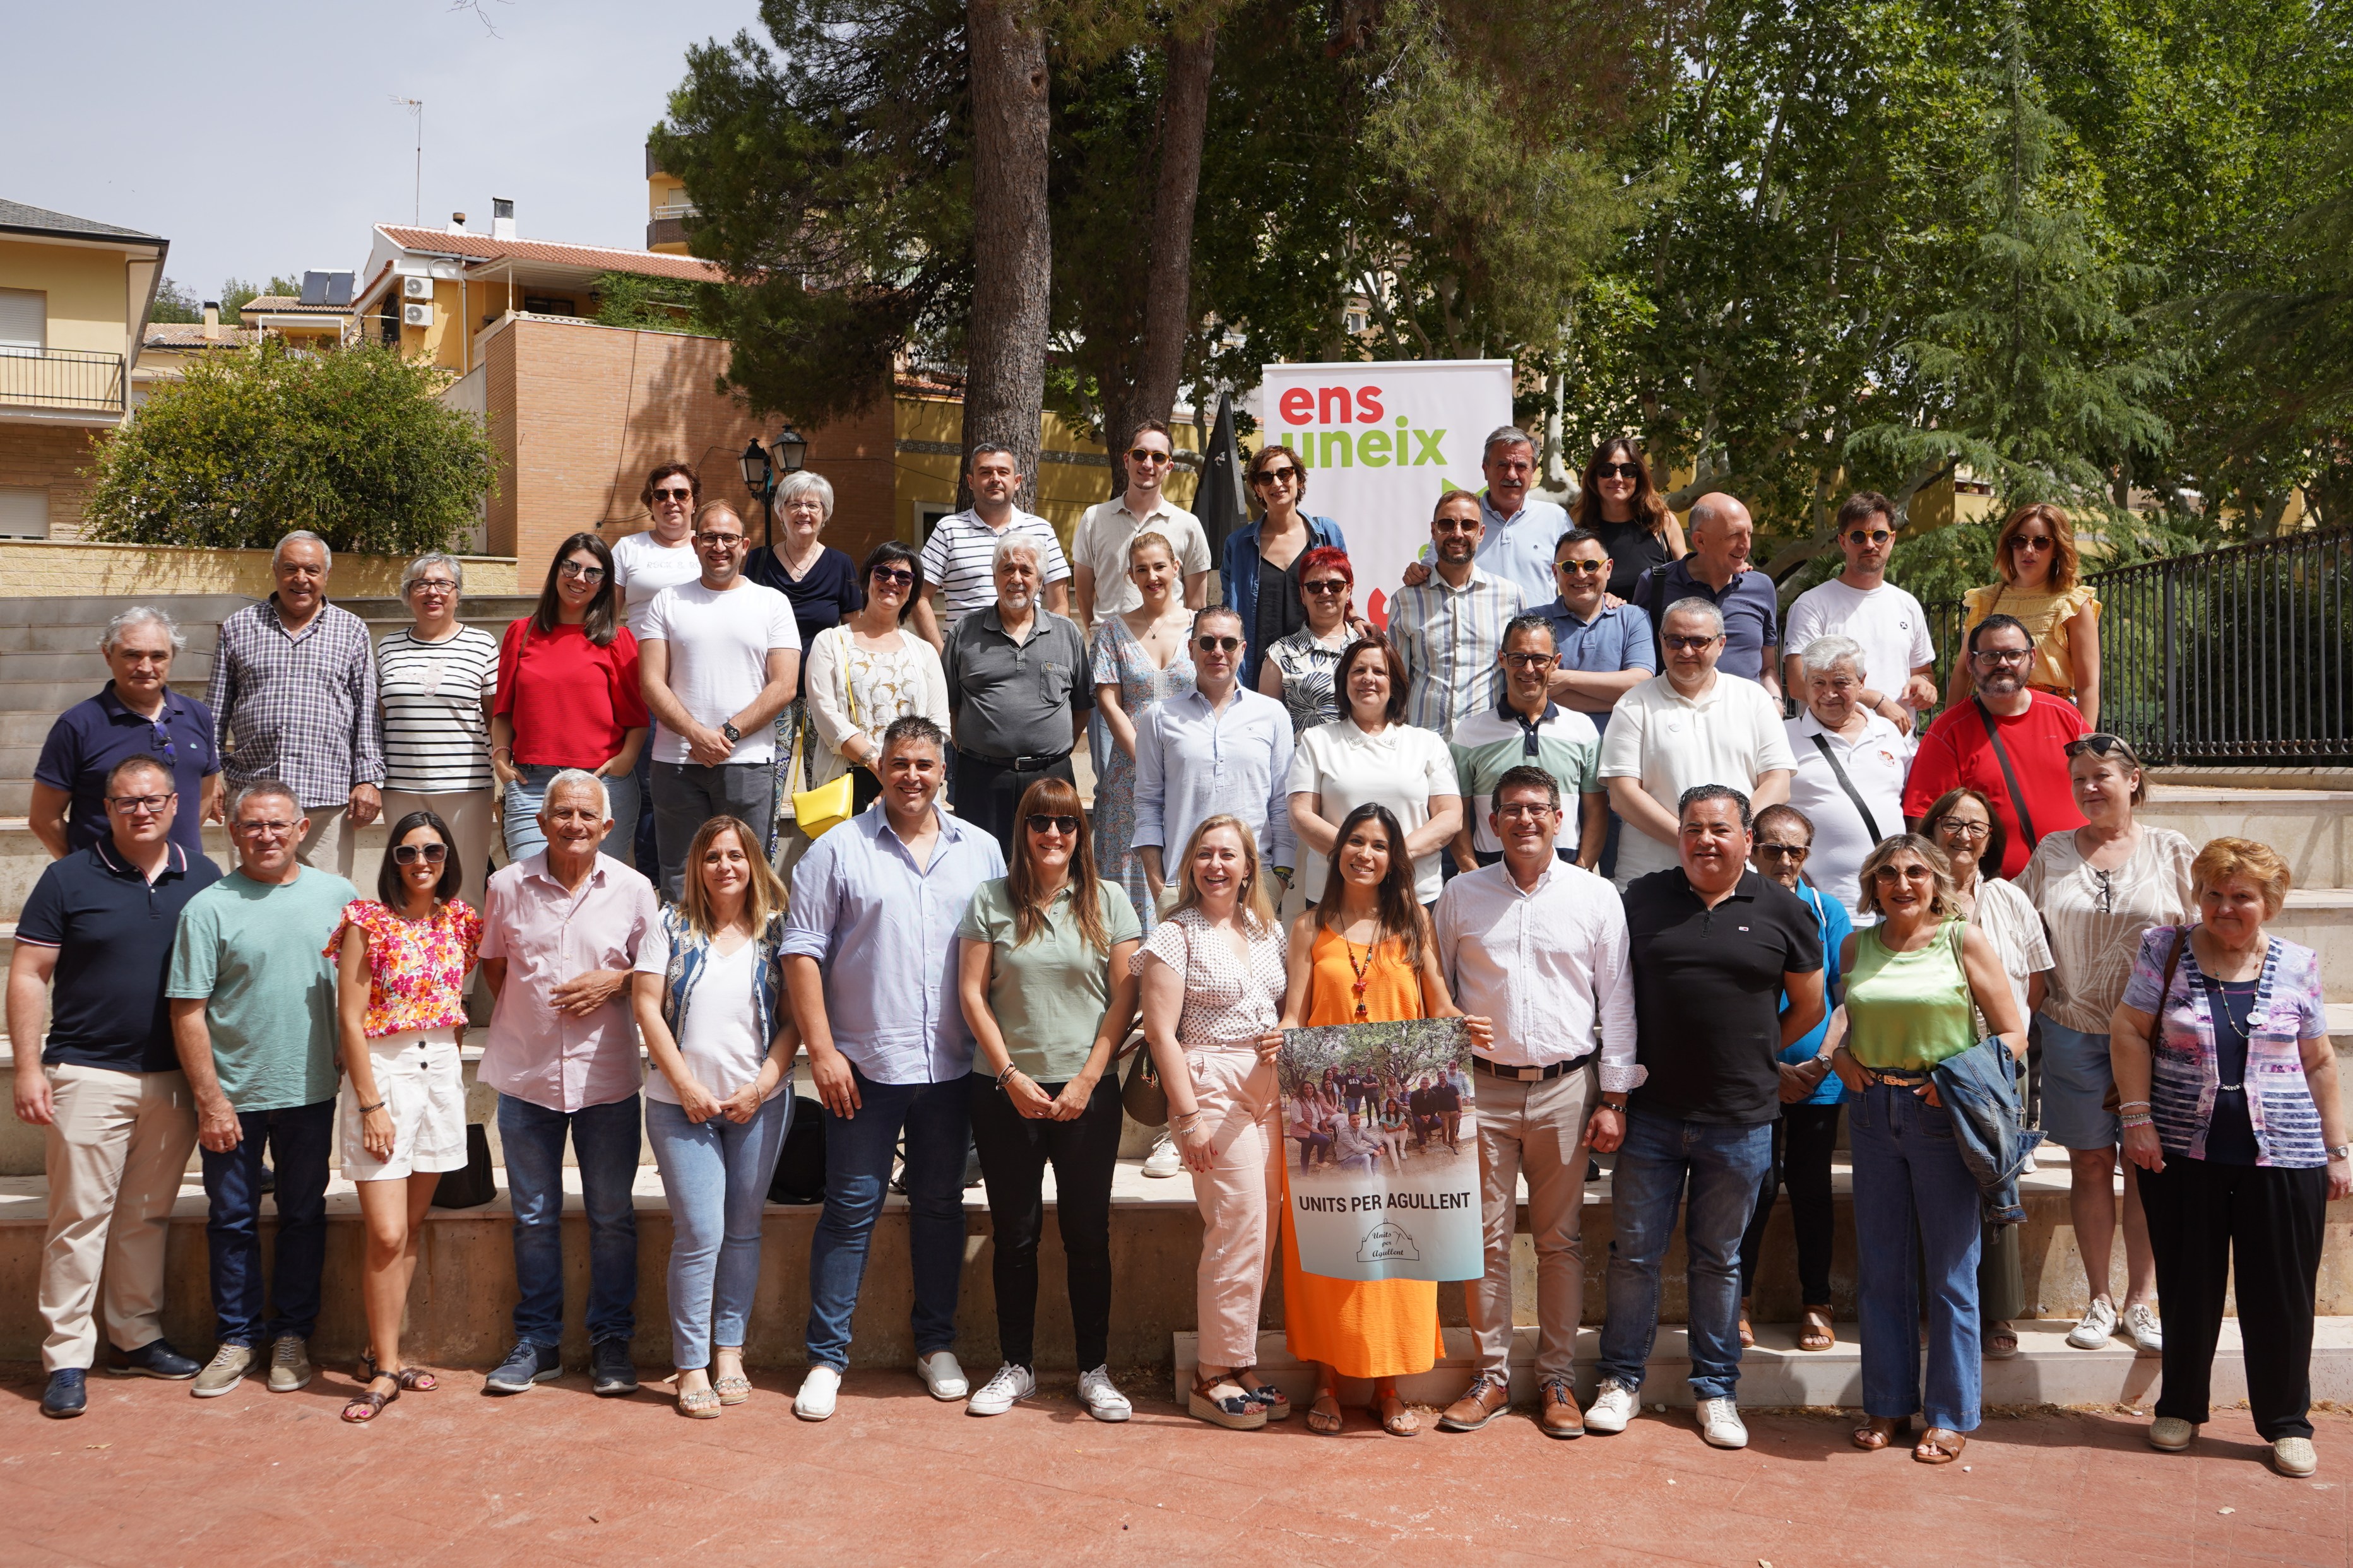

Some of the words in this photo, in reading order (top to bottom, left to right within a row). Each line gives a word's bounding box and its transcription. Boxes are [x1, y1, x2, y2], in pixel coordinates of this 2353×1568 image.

[1279, 386, 1384, 426] ens
[1281, 415, 1448, 469] uneix
[646, 560, 672, 569] ROCK
[677, 561, 685, 569] &
[1298, 1196, 1347, 1213] UNITS
[1351, 1194, 1382, 1212] PER
[1387, 1192, 1471, 1210] AGULLENT
[1372, 1231, 1392, 1239] Units
[1372, 1248, 1404, 1258] Agullent
